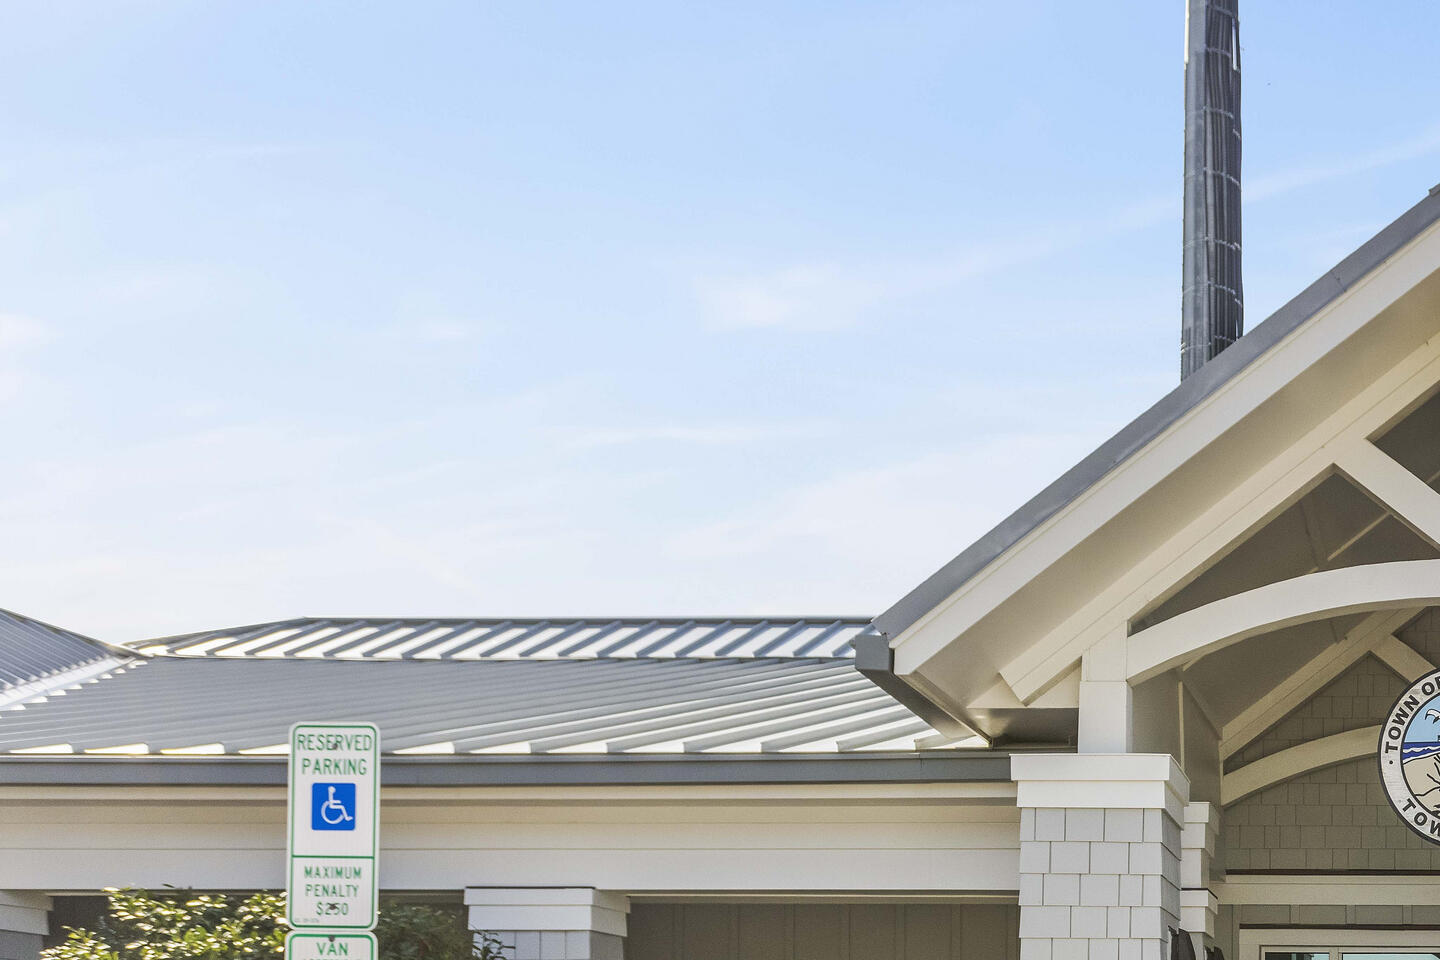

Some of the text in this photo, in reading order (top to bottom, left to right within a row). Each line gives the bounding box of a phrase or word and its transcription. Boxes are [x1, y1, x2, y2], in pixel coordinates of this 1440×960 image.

[1385, 695, 1420, 754] TOWN
[298, 734, 372, 752] RESERVED
[302, 758, 367, 776] PARKING
[304, 866, 362, 879] MAXIMUM
[305, 885, 359, 897] PENALTY
[316, 902, 349, 916] $250
[316, 942, 348, 956] VAN
